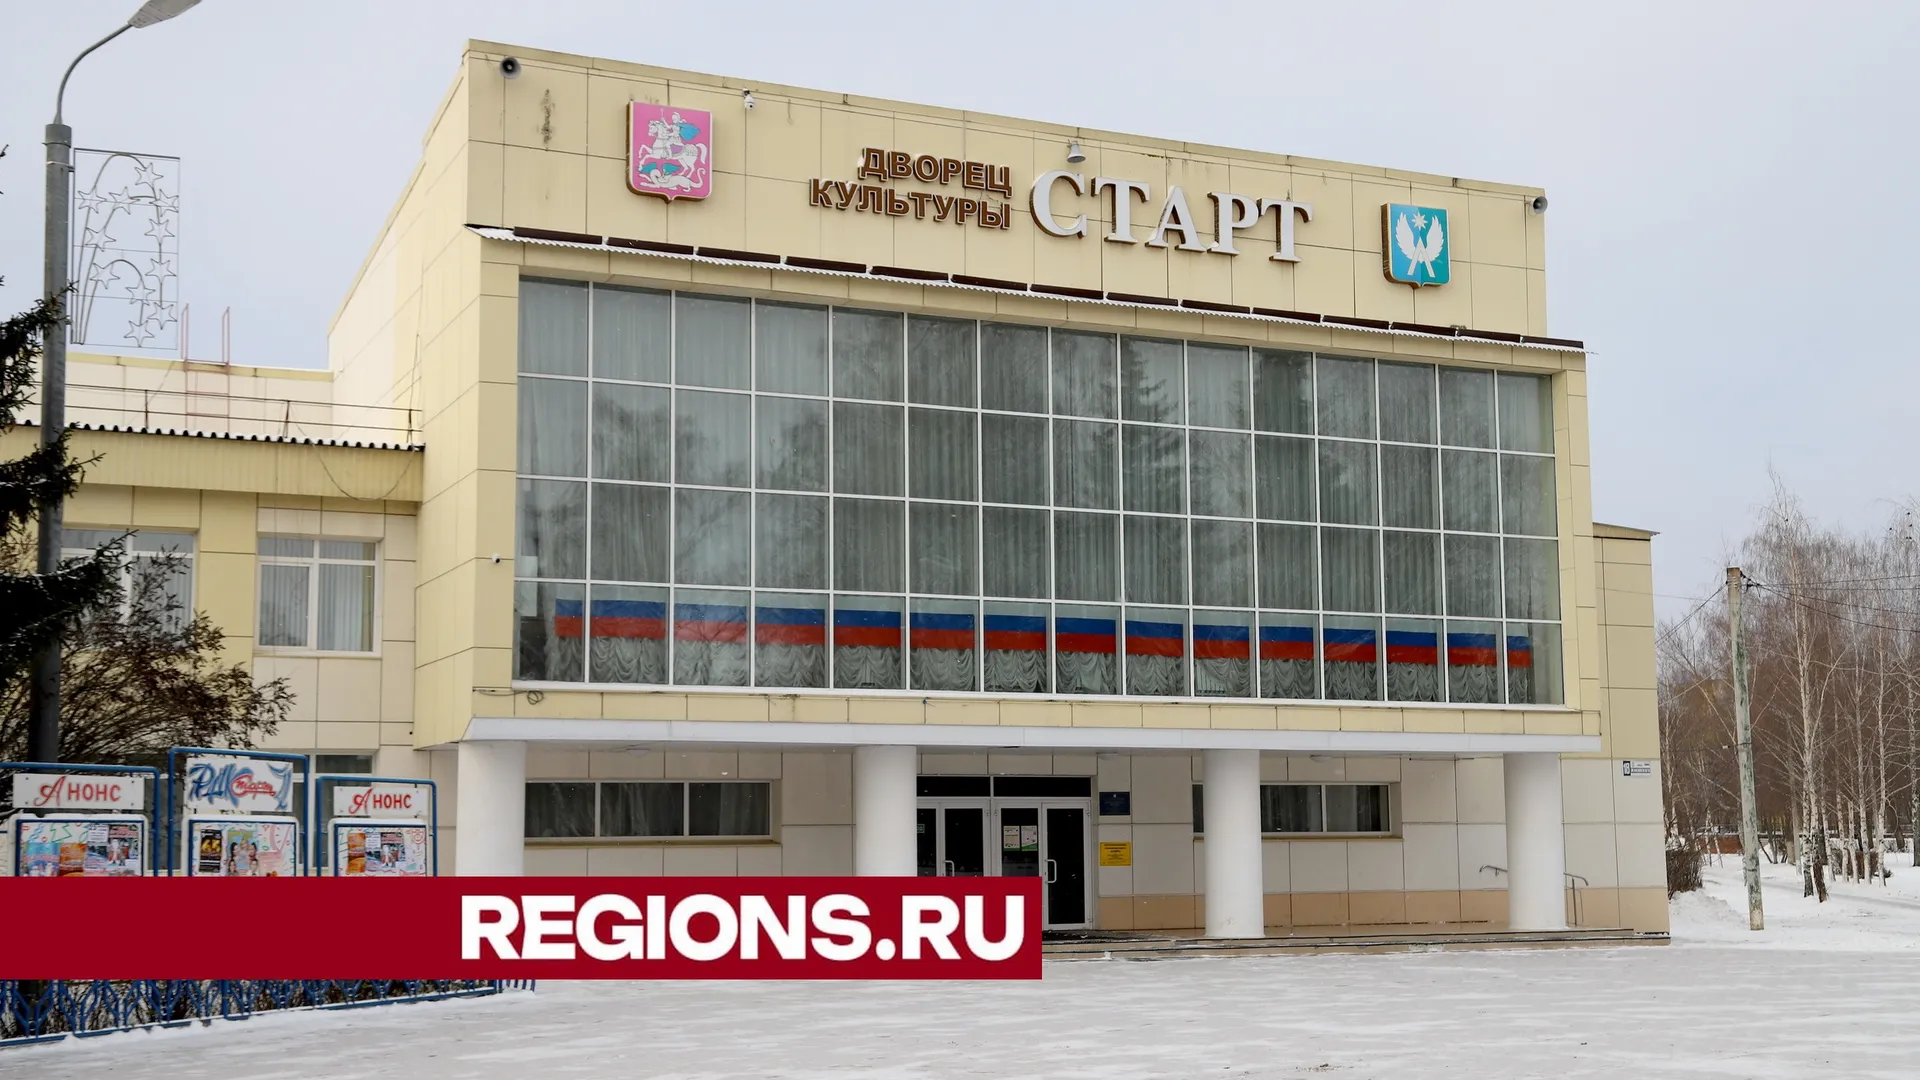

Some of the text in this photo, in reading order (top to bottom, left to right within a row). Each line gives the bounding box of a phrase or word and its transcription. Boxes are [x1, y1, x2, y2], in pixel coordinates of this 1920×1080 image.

[858, 147, 1012, 198] ДВОРЕЦ
[810, 178, 1011, 229] КУЛЬТУРЫ
[1029, 170, 1312, 263] СТАРТ
